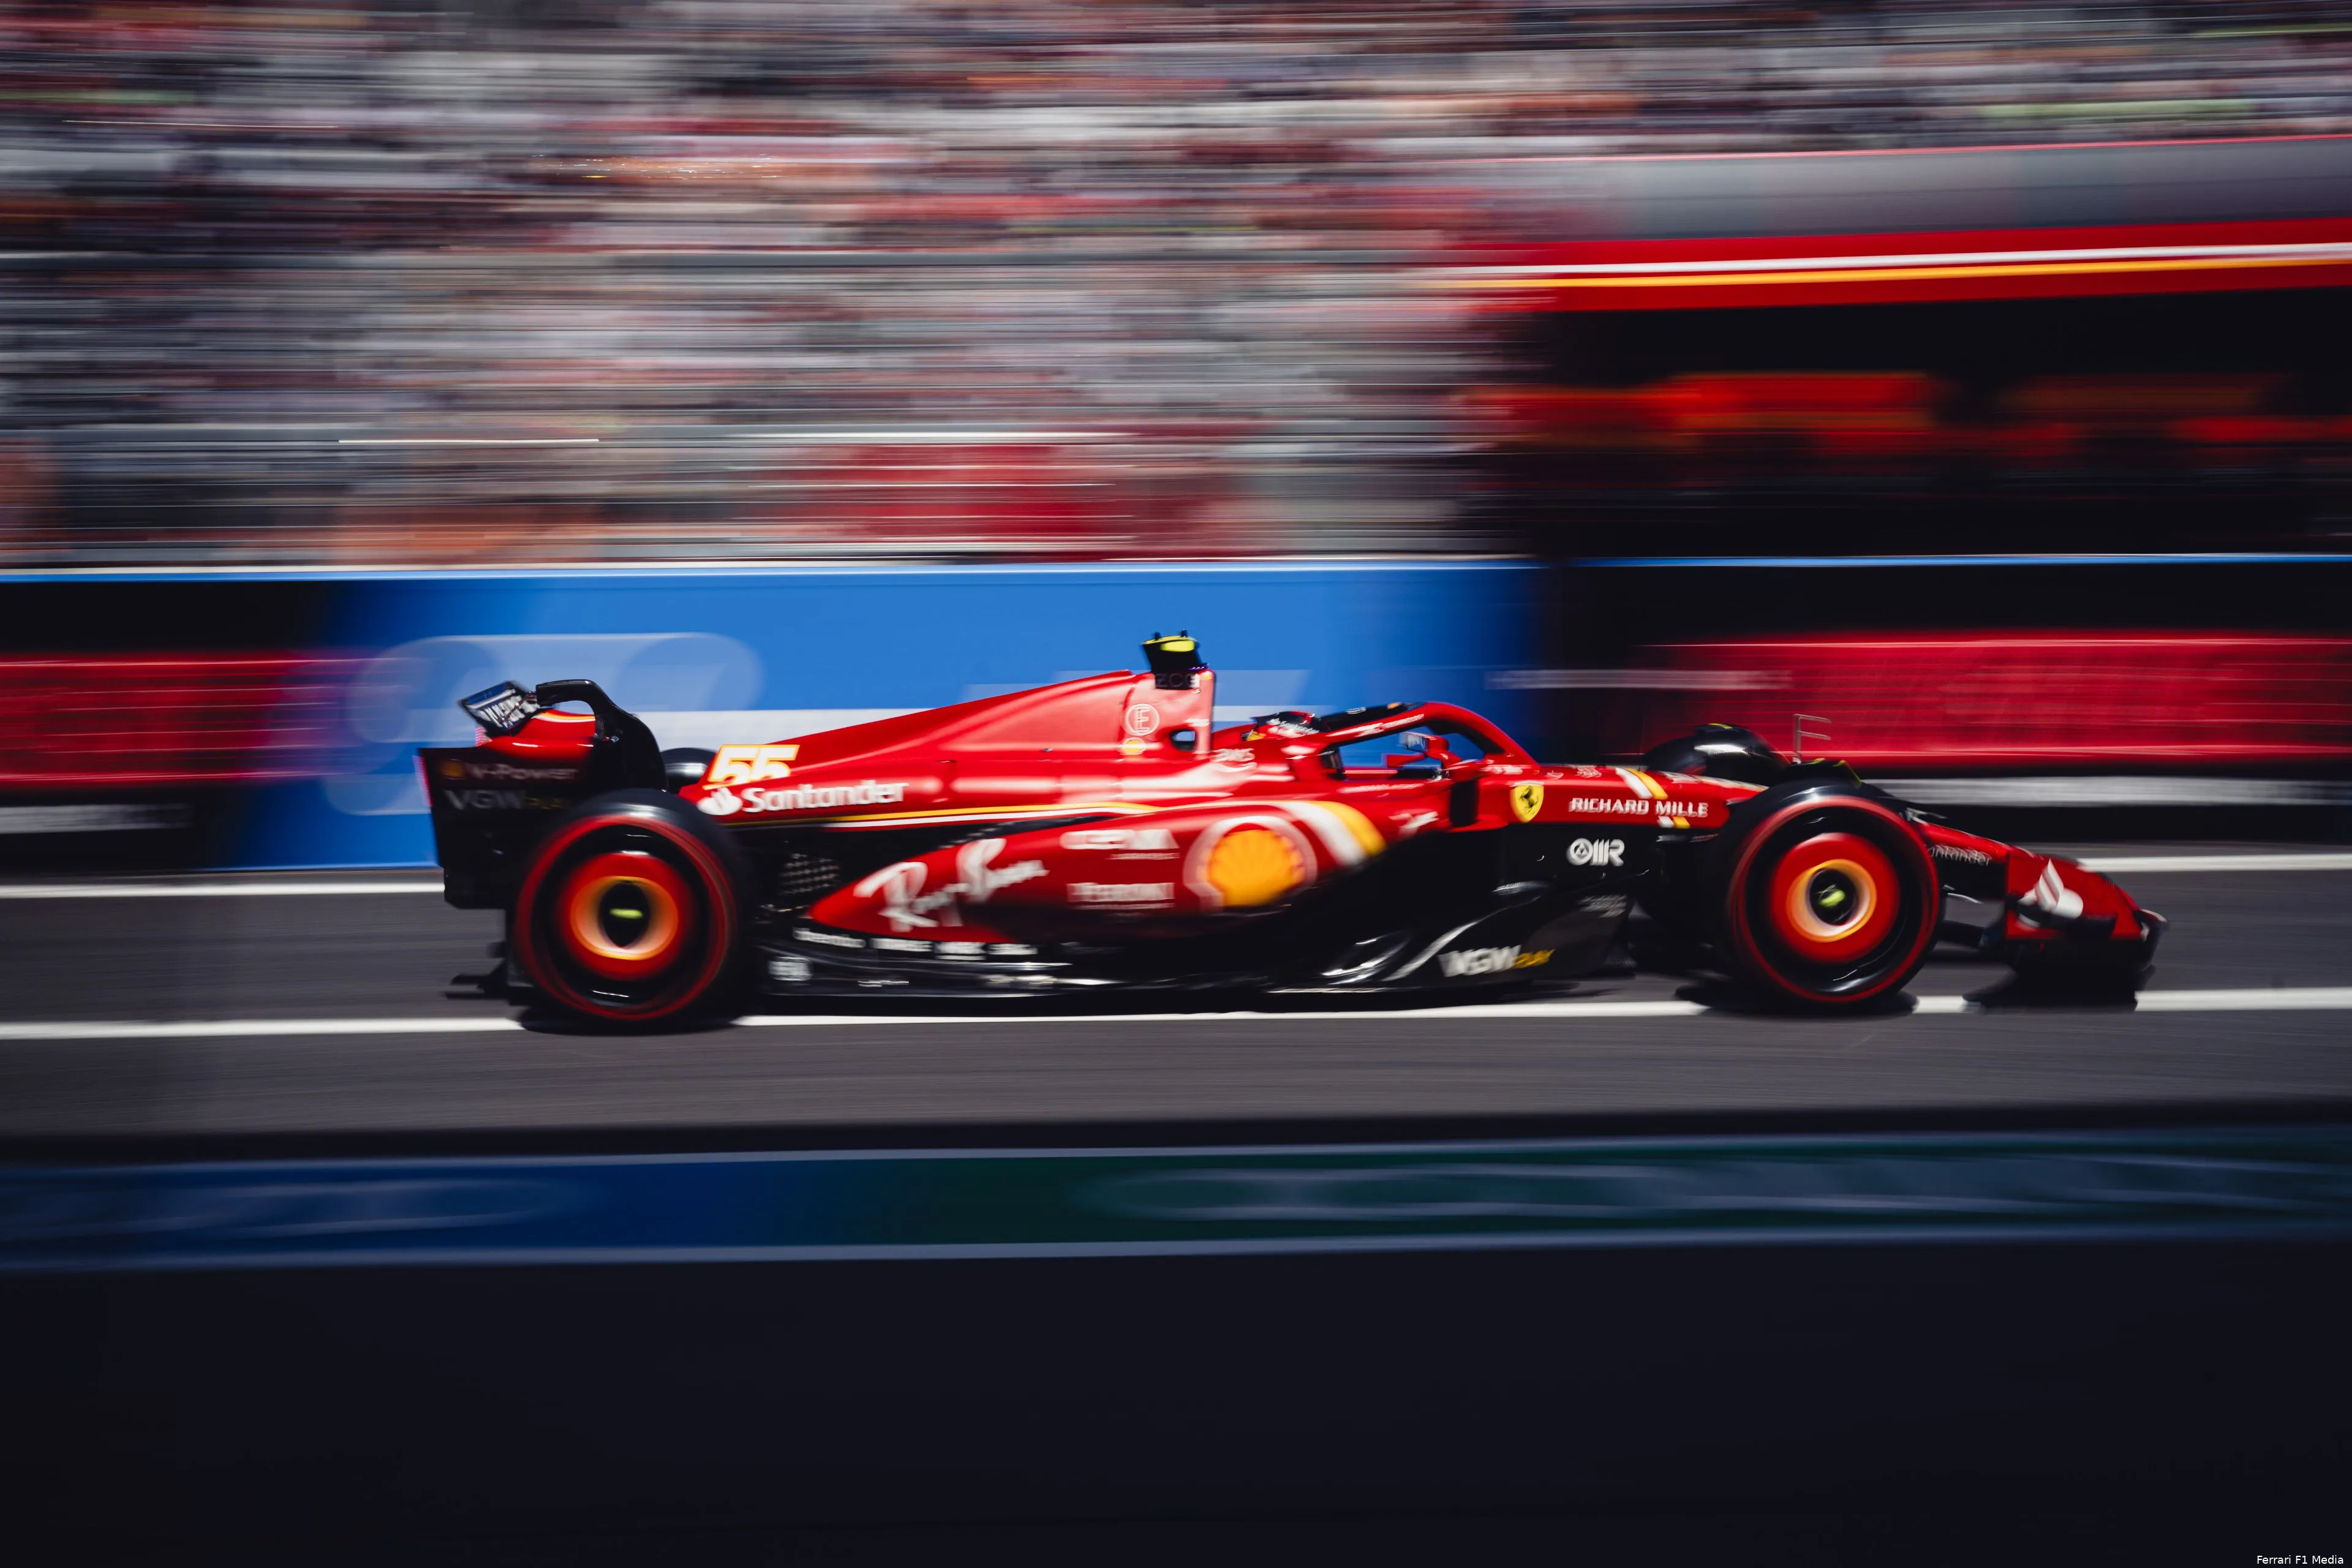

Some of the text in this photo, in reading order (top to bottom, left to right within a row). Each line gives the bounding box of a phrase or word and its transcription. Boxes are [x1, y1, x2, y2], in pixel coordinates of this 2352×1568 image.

[703, 744, 800, 790] 55
[741, 779, 909, 813] Santander
[1568, 797, 1709, 818] RICHARD MILLE
[1926, 844, 1992, 867] antander
